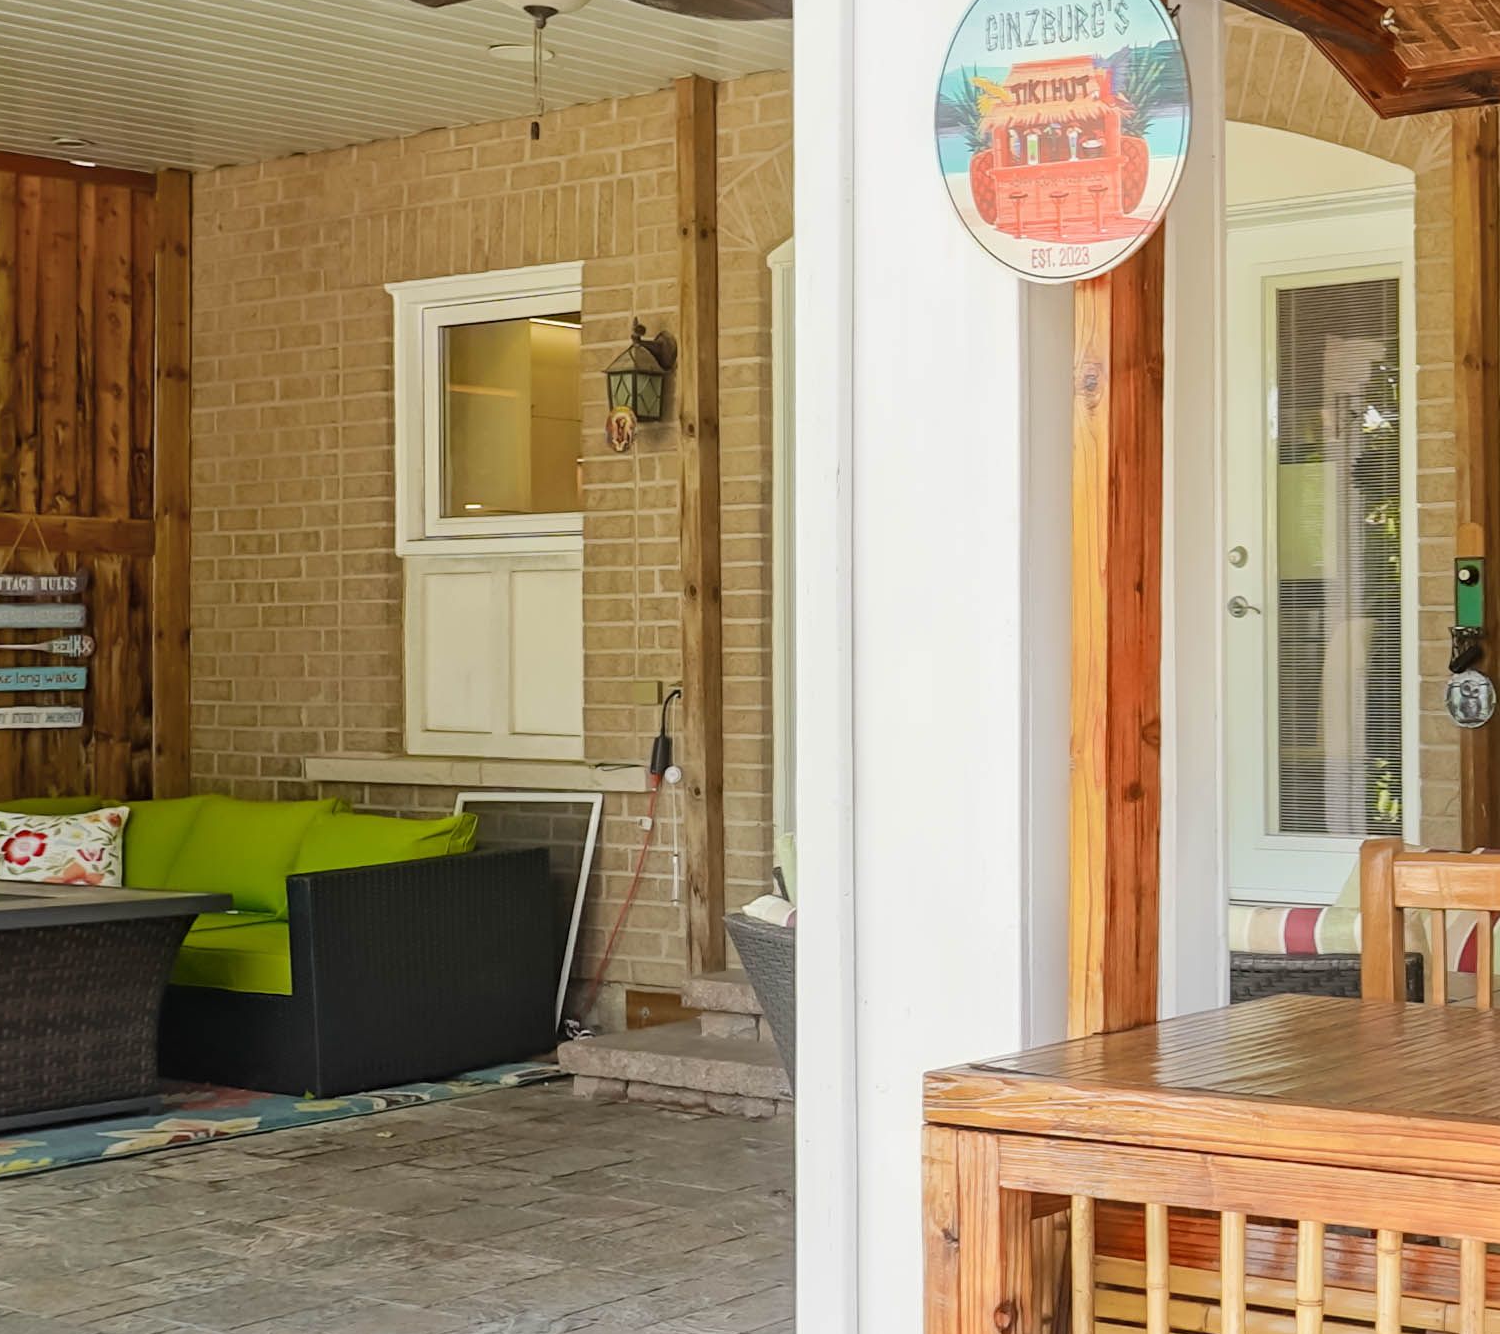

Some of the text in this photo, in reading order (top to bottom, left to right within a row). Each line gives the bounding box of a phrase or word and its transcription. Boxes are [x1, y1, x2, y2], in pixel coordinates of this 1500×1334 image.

[1010, 75, 1090, 105] TIKI HUT
[1031, 246, 1091, 269] EST. 2023
[40, 576, 77, 591] RULES
[16, 672, 40, 687] long
[44, 671, 77, 683] walks
